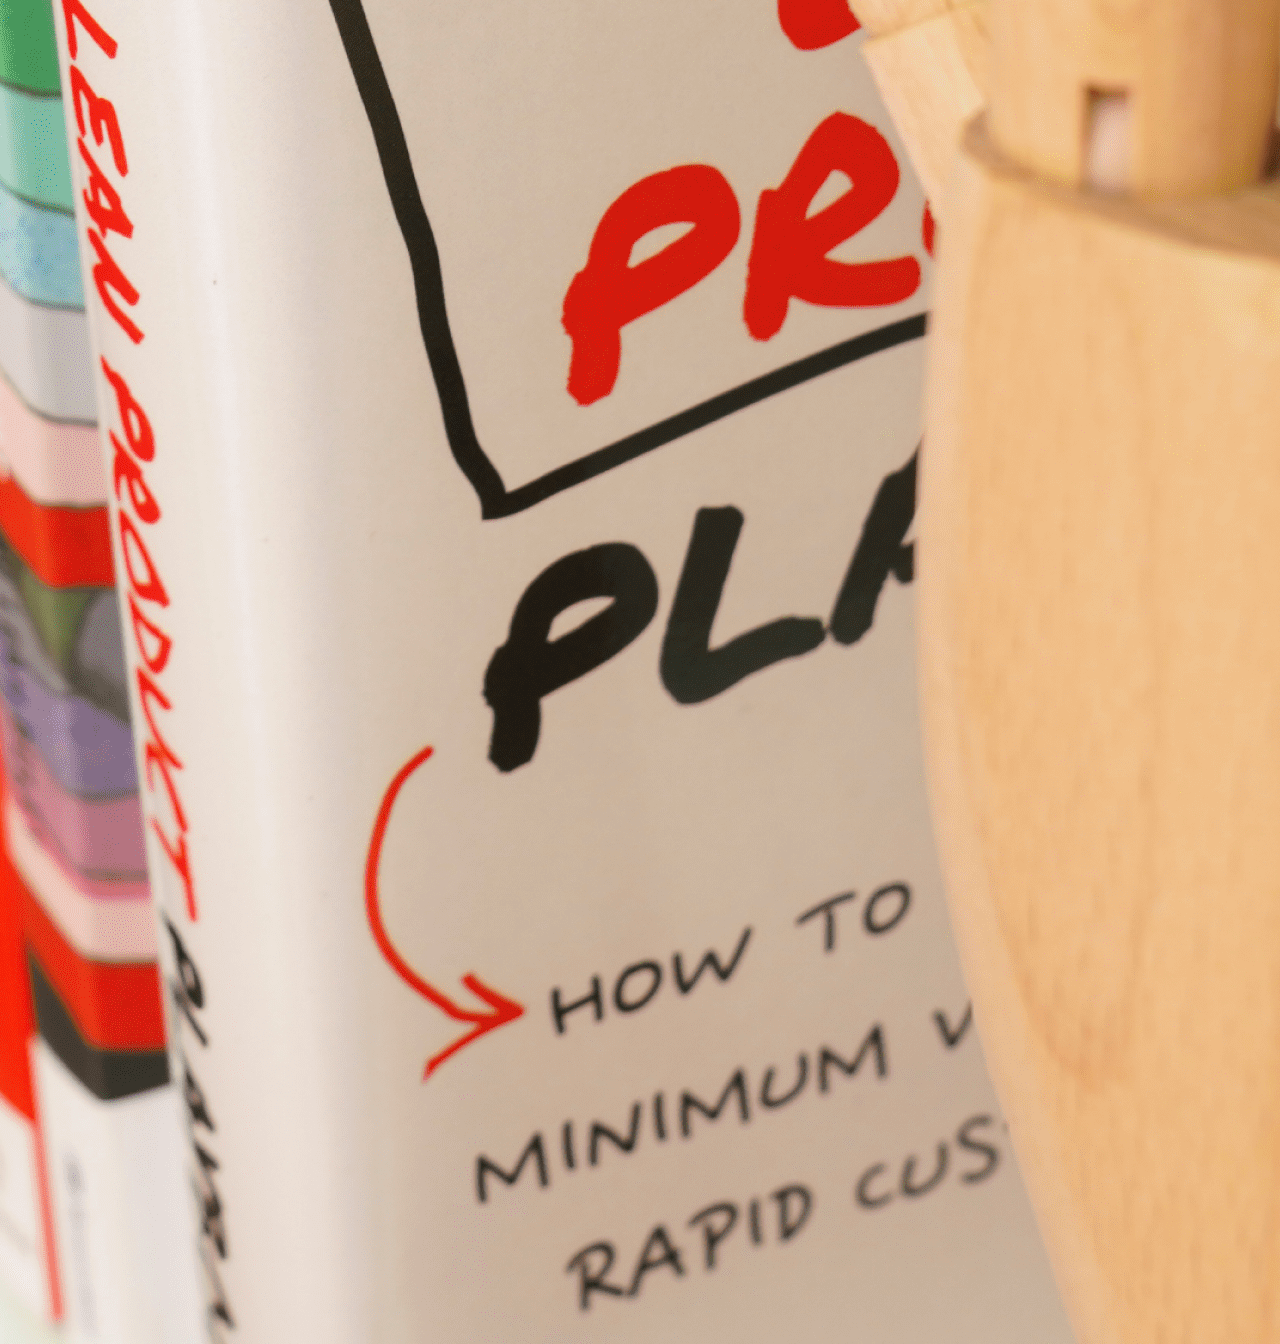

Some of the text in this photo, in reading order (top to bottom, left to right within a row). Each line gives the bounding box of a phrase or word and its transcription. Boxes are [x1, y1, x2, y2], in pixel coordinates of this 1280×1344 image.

[561, 112, 935, 406] PR
[100, 353, 198, 922] PRODUCT
[549, 881, 913, 1036] HOW TO
[472, 1021, 890, 1205] MINIMUM
[564, 1112, 1011, 1312] RAPID CUS
